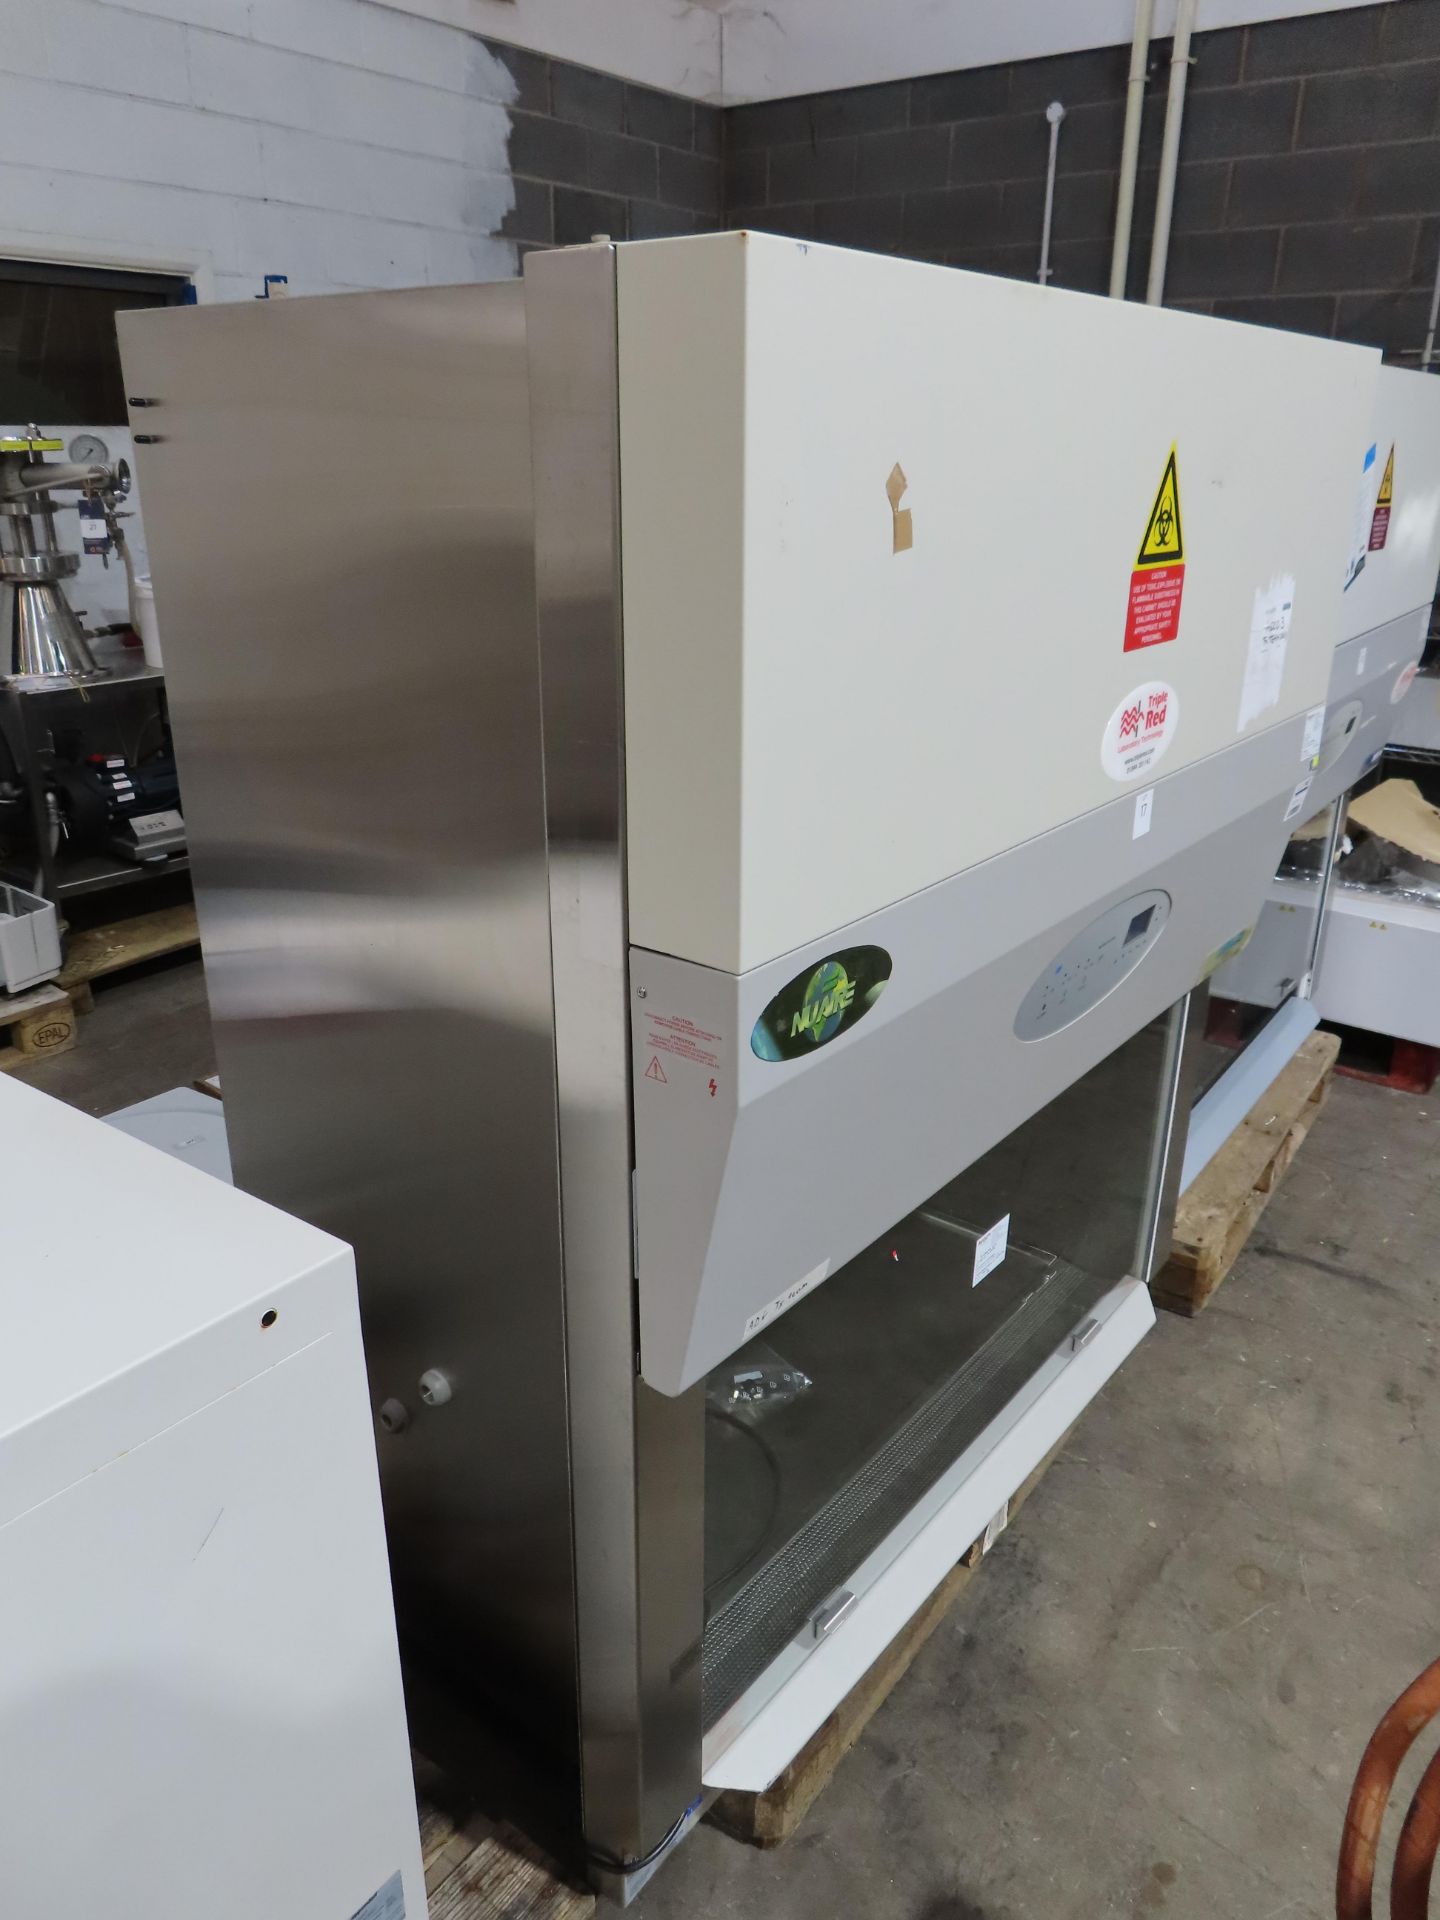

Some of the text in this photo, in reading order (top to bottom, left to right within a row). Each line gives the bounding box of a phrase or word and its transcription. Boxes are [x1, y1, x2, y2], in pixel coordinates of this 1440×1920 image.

[1148, 691, 1168, 708] Triple
[1145, 705, 1167, 730] Red
[790, 981, 857, 1037] NUAIRE
[38, 1027, 67, 1044] EPAL
